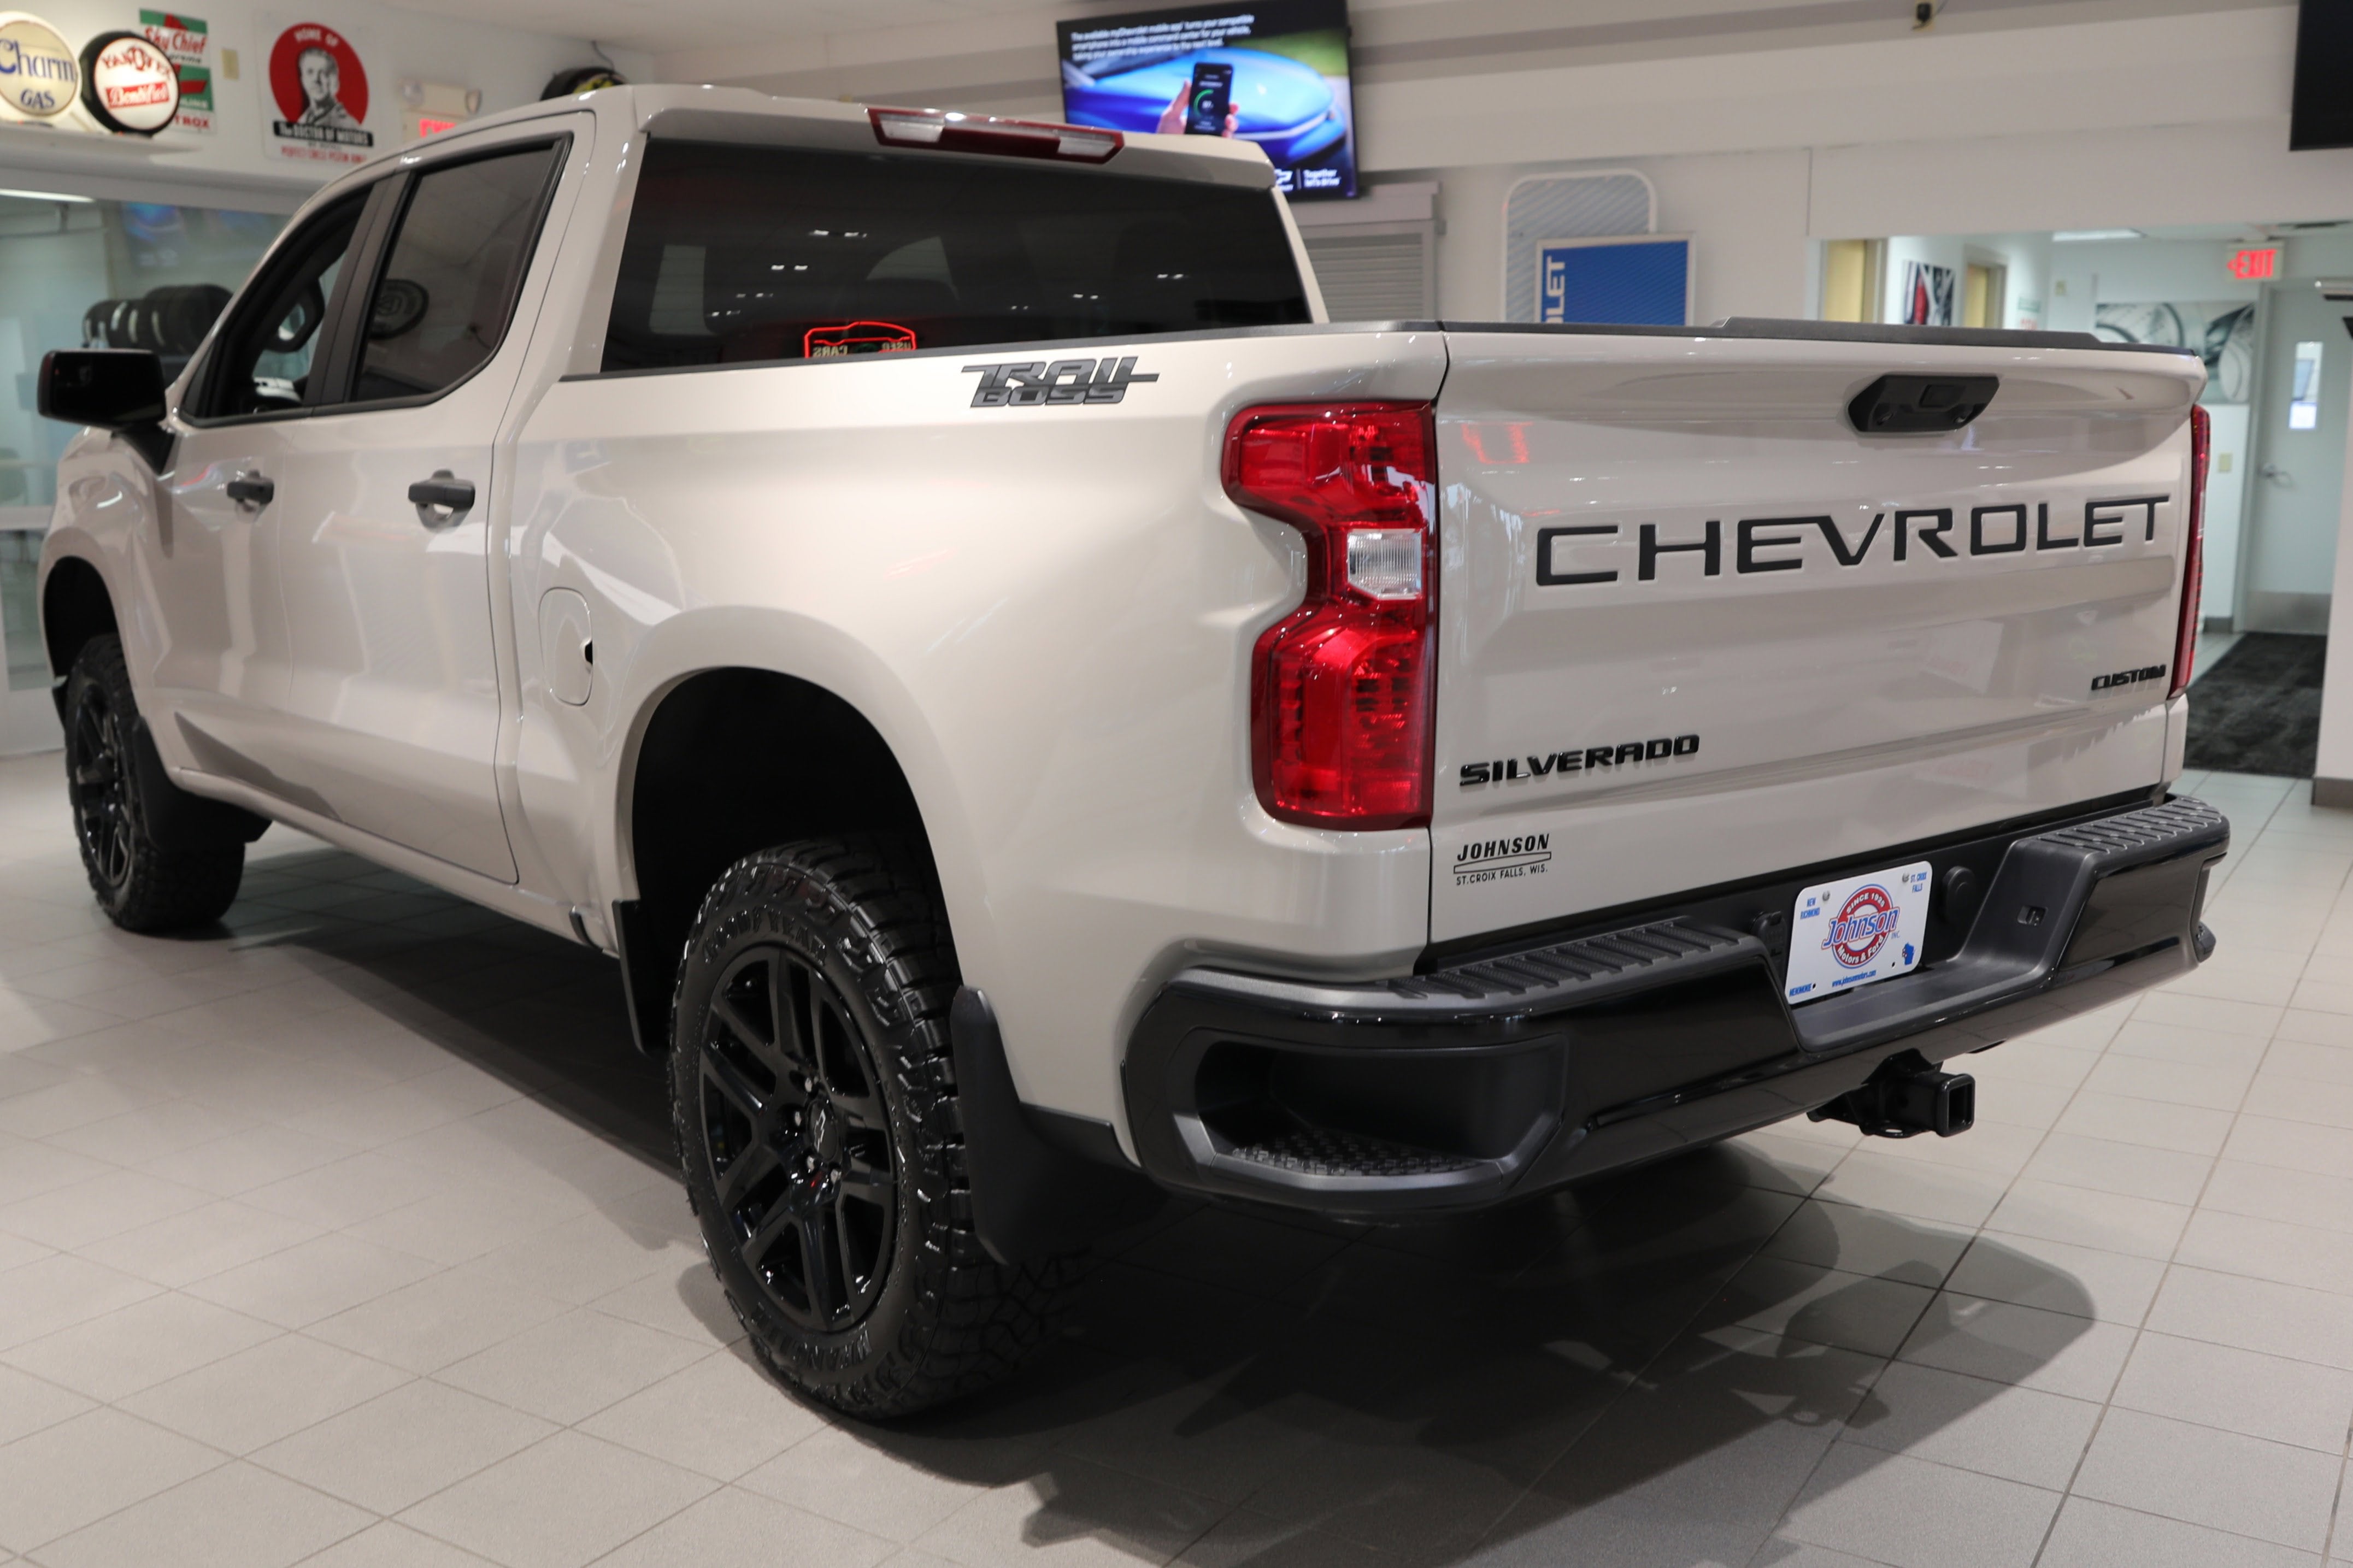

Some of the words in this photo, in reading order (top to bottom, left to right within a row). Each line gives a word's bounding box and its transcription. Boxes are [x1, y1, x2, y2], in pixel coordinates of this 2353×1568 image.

[172, 31, 207, 54] Chief
[20, 89, 55, 109] GAS
[2235, 249, 2276, 279] EXIT
[961, 356, 1160, 388] TRAIL
[970, 382, 1129, 408] BOSS
[1536, 495, 2170, 587] CHEVROLET
[2091, 663, 2167, 691] CUSTOM
[1460, 734, 1699, 786] SILVERADO
[1457, 834, 1550, 862] JOHNSON
[1530, 863, 1548, 874] WIS.
[1846, 892, 1869, 914] SINCE
[702, 904, 828, 967] GOODYEAR
[1822, 908, 1899, 948] Johnson
[1837, 944, 1860, 964] Motors
[1861, 952, 1867, 961] &
[1867, 936, 1885, 958] Ford
